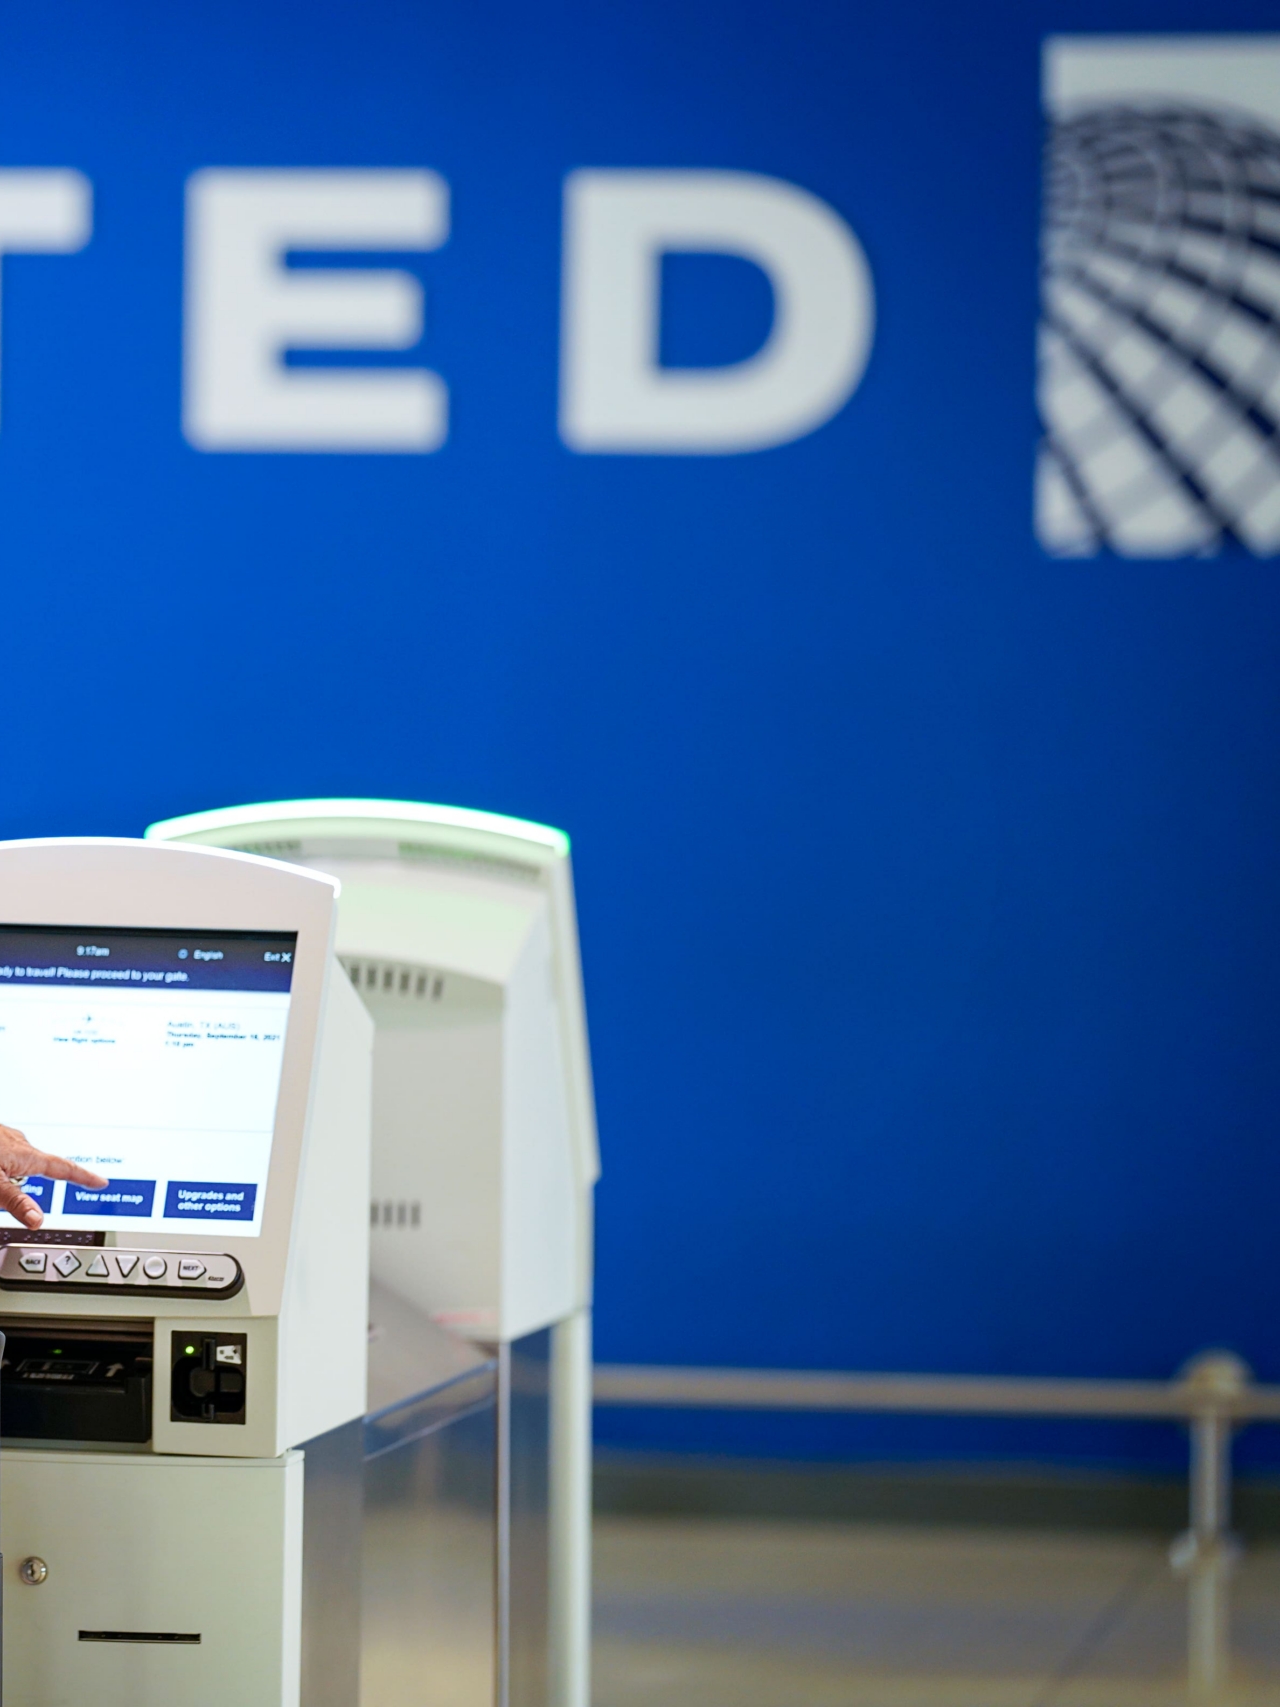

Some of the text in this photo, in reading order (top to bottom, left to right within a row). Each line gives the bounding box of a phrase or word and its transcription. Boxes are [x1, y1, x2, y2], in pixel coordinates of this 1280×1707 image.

[193, 949, 224, 961] English
[263, 951, 280, 962] Exit
[14, 966, 25, 977] to
[57, 967, 90, 979] Please
[90, 968, 131, 981] proceed
[131, 969, 141, 980] to
[142, 971, 165, 982] your
[165, 971, 190, 983] gate.
[75, 1190, 144, 1205] View seat map
[177, 1189, 245, 1202] Upgrades and
[177, 1201, 241, 1214] other options
[24, 1258, 41, 1266] BACK
[182, 1264, 200, 1272] NEXT
